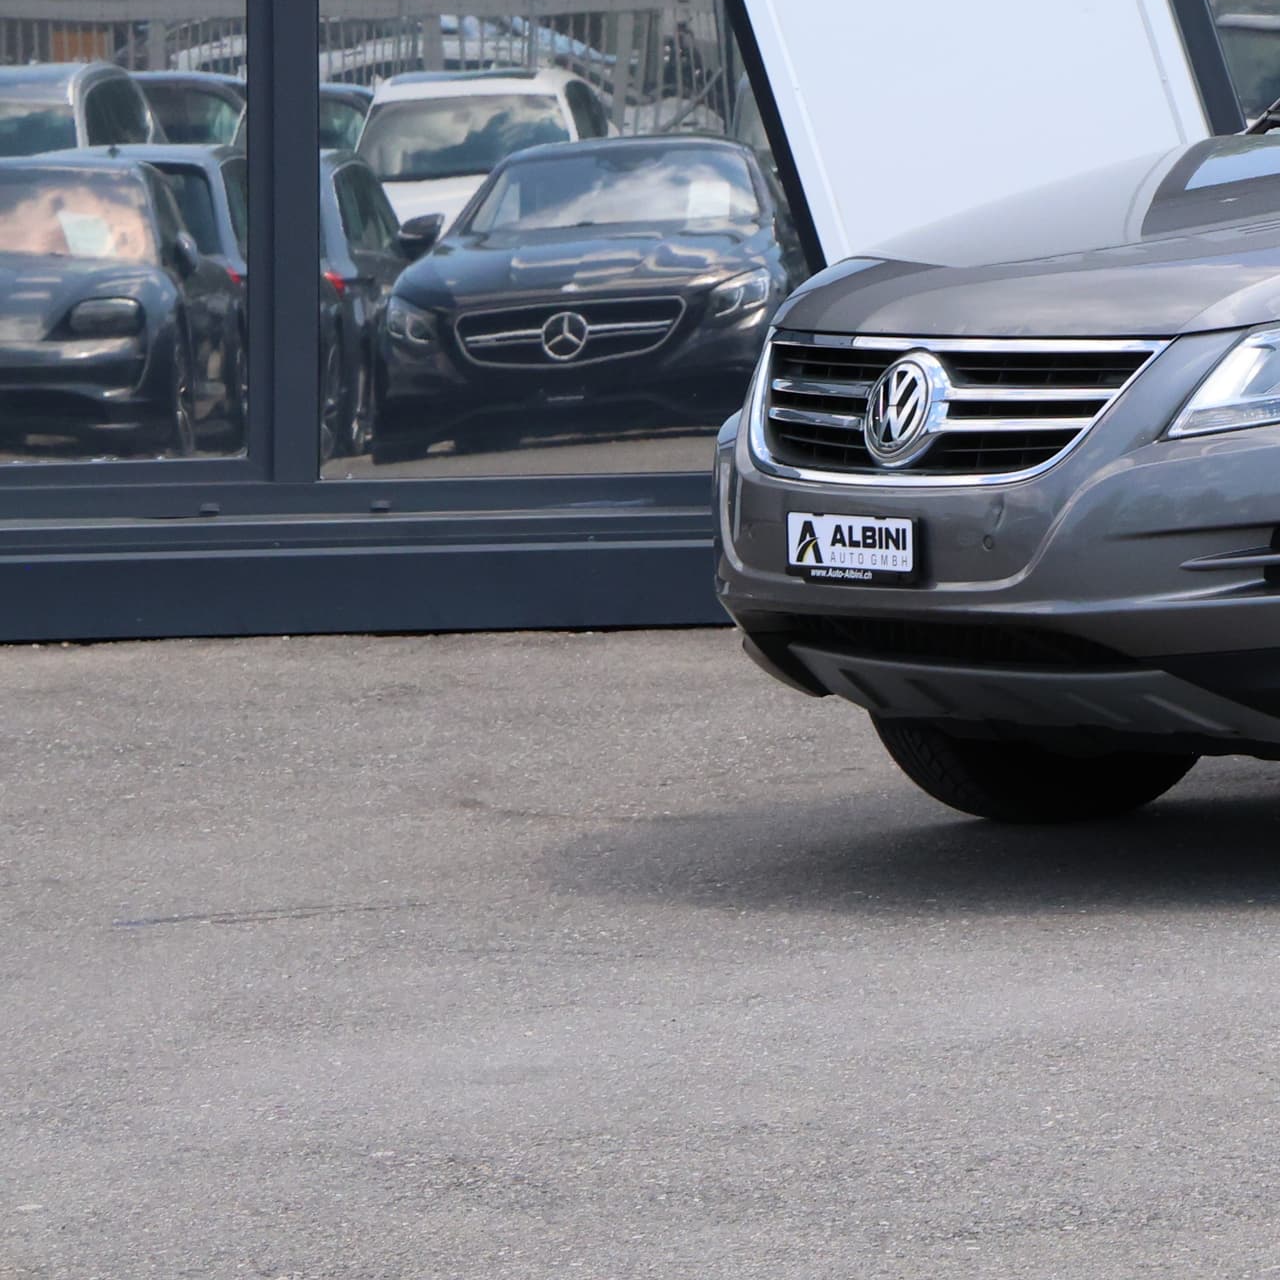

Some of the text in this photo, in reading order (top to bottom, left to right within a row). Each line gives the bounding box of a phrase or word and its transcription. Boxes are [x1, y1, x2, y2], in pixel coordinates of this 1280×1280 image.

[830, 524, 907, 551] ALBINI
[830, 551, 908, 567] AUTO GMBH
[810, 568, 873, 580] www.Auto-Albini.ch
